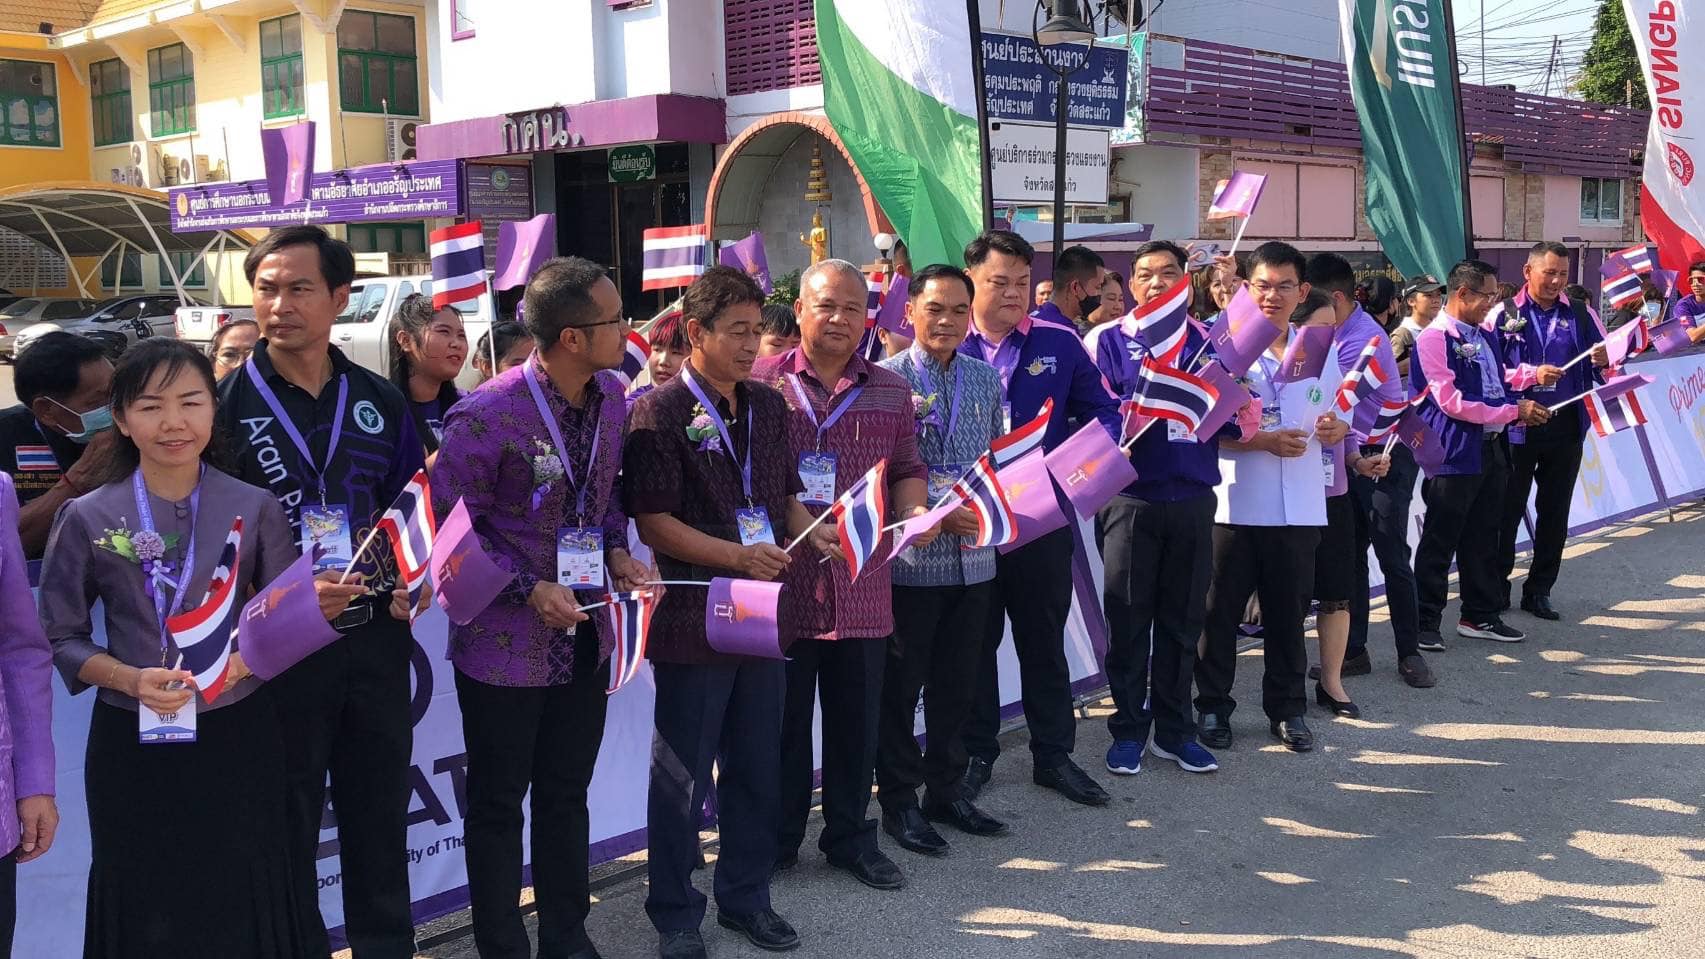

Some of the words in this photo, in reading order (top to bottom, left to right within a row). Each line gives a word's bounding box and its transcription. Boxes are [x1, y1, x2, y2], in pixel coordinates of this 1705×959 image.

[985, 74, 1042, 99] รคุมประพฤติ
[1048, 79, 1119, 102] กรรวงยุติธรรม
[986, 92, 1034, 117] รัญประเทศ
[1049, 97, 1111, 121] จัวัดสระแก้ว
[990, 143, 1107, 170] ศูนย์บริการร่วมกรรวงแรงงาน
[1023, 175, 1077, 192] จังหวัดสก้ว
[240, 416, 288, 485] Aran
[158, 712, 177, 723] VIP
[426, 840, 440, 857] of
[443, 834, 466, 852] Tha
